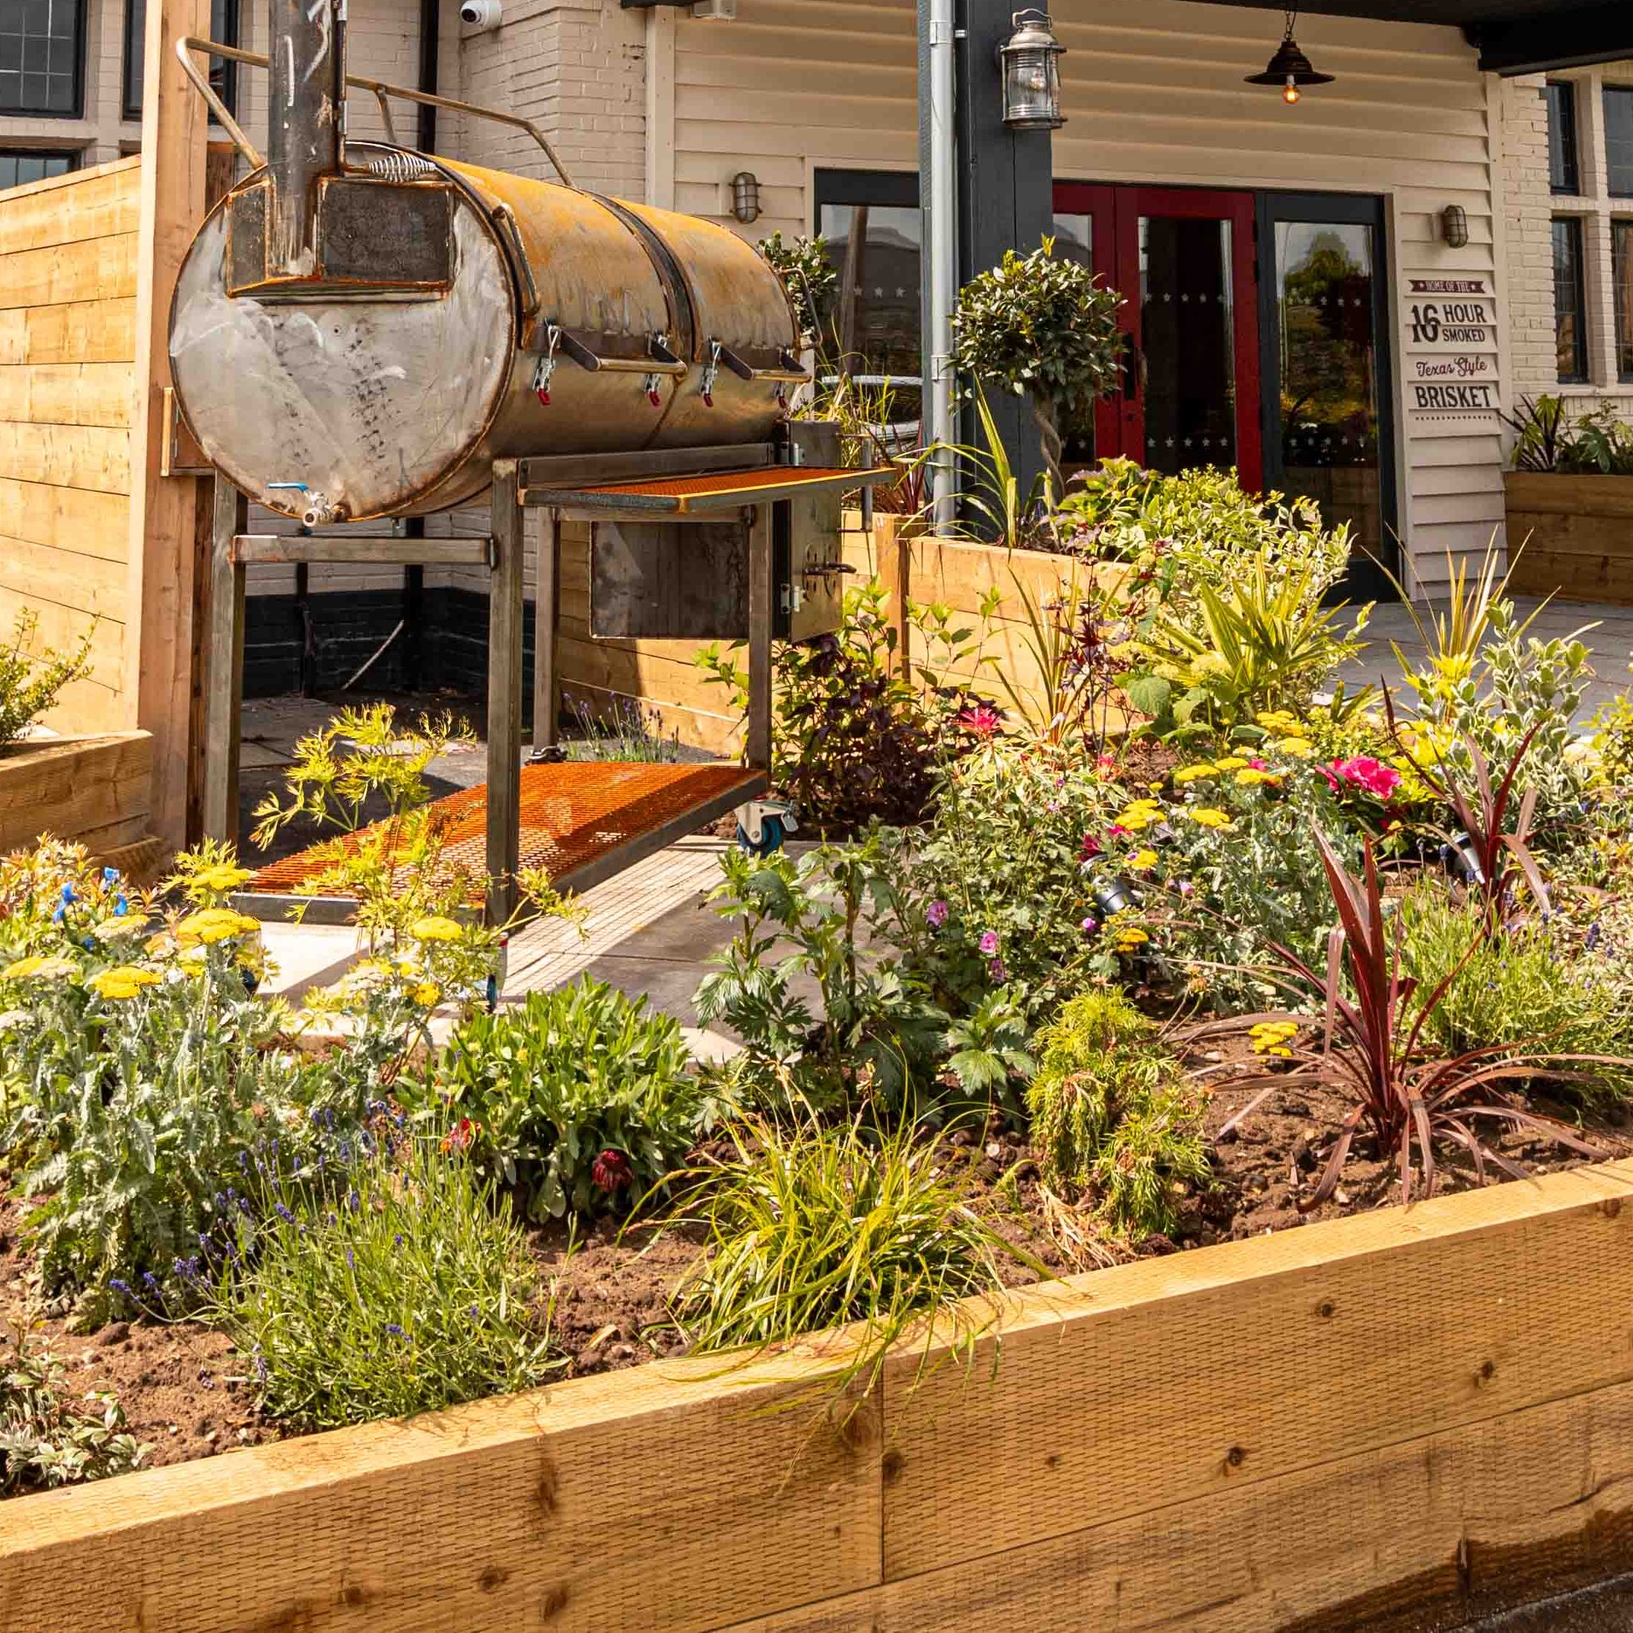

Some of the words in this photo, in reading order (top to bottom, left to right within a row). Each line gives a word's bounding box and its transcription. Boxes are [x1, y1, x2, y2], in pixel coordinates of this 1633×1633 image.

[1425, 280, 1445, 291] HOME
[1446, 280, 1455, 292] OF
[1457, 281, 1470, 292] THE
[1411, 304, 1441, 343] 16
[1442, 304, 1487, 323] HOUR
[1442, 328, 1486, 342] SMOKED
[1416, 361, 1455, 377] Texas
[1454, 355, 1488, 377] Style
[1415, 386, 1491, 408] BRISKET
